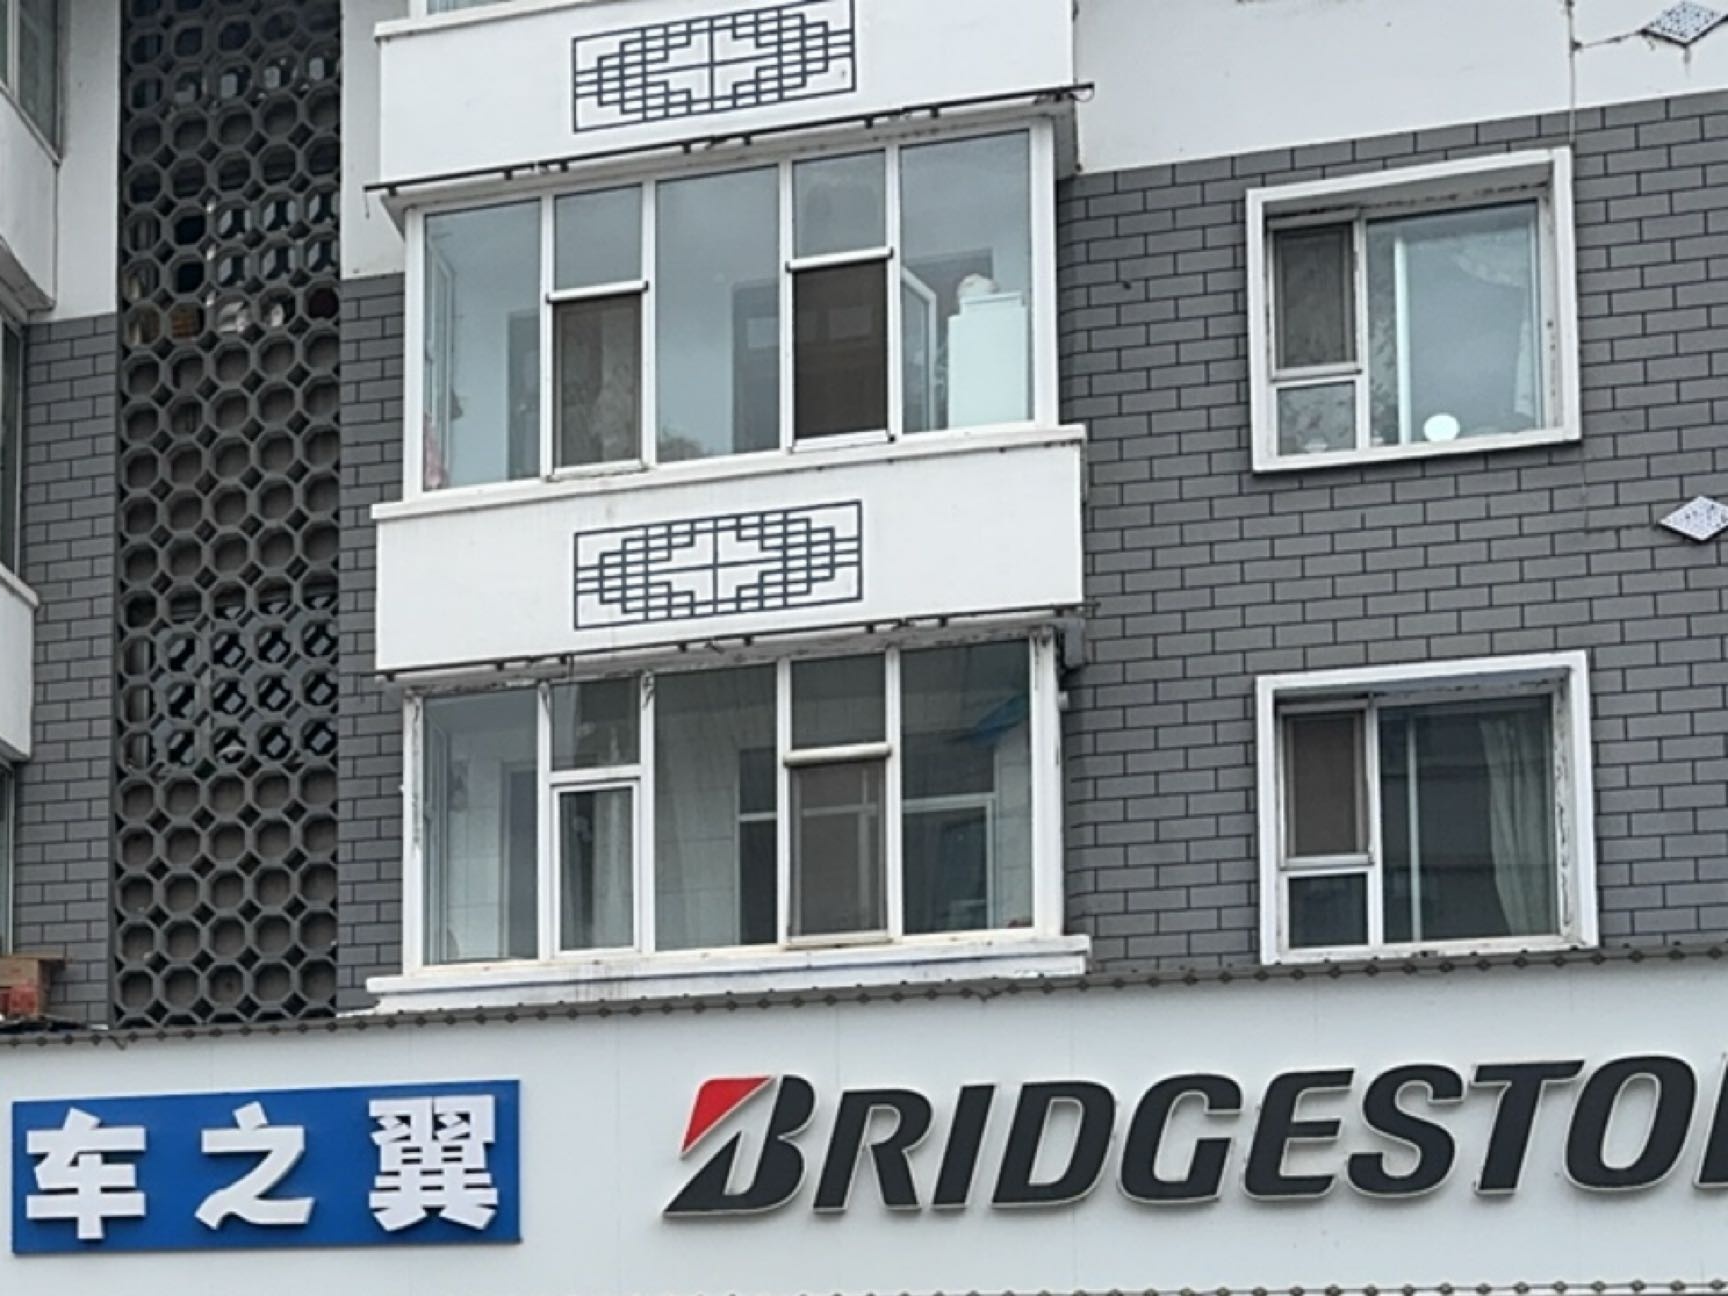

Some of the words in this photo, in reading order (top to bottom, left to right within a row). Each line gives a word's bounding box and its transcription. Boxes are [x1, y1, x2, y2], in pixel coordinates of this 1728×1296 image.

[26, 1094, 498, 1240] 车之翼
[662, 1054, 1728, 1216] BRIDGESTO
